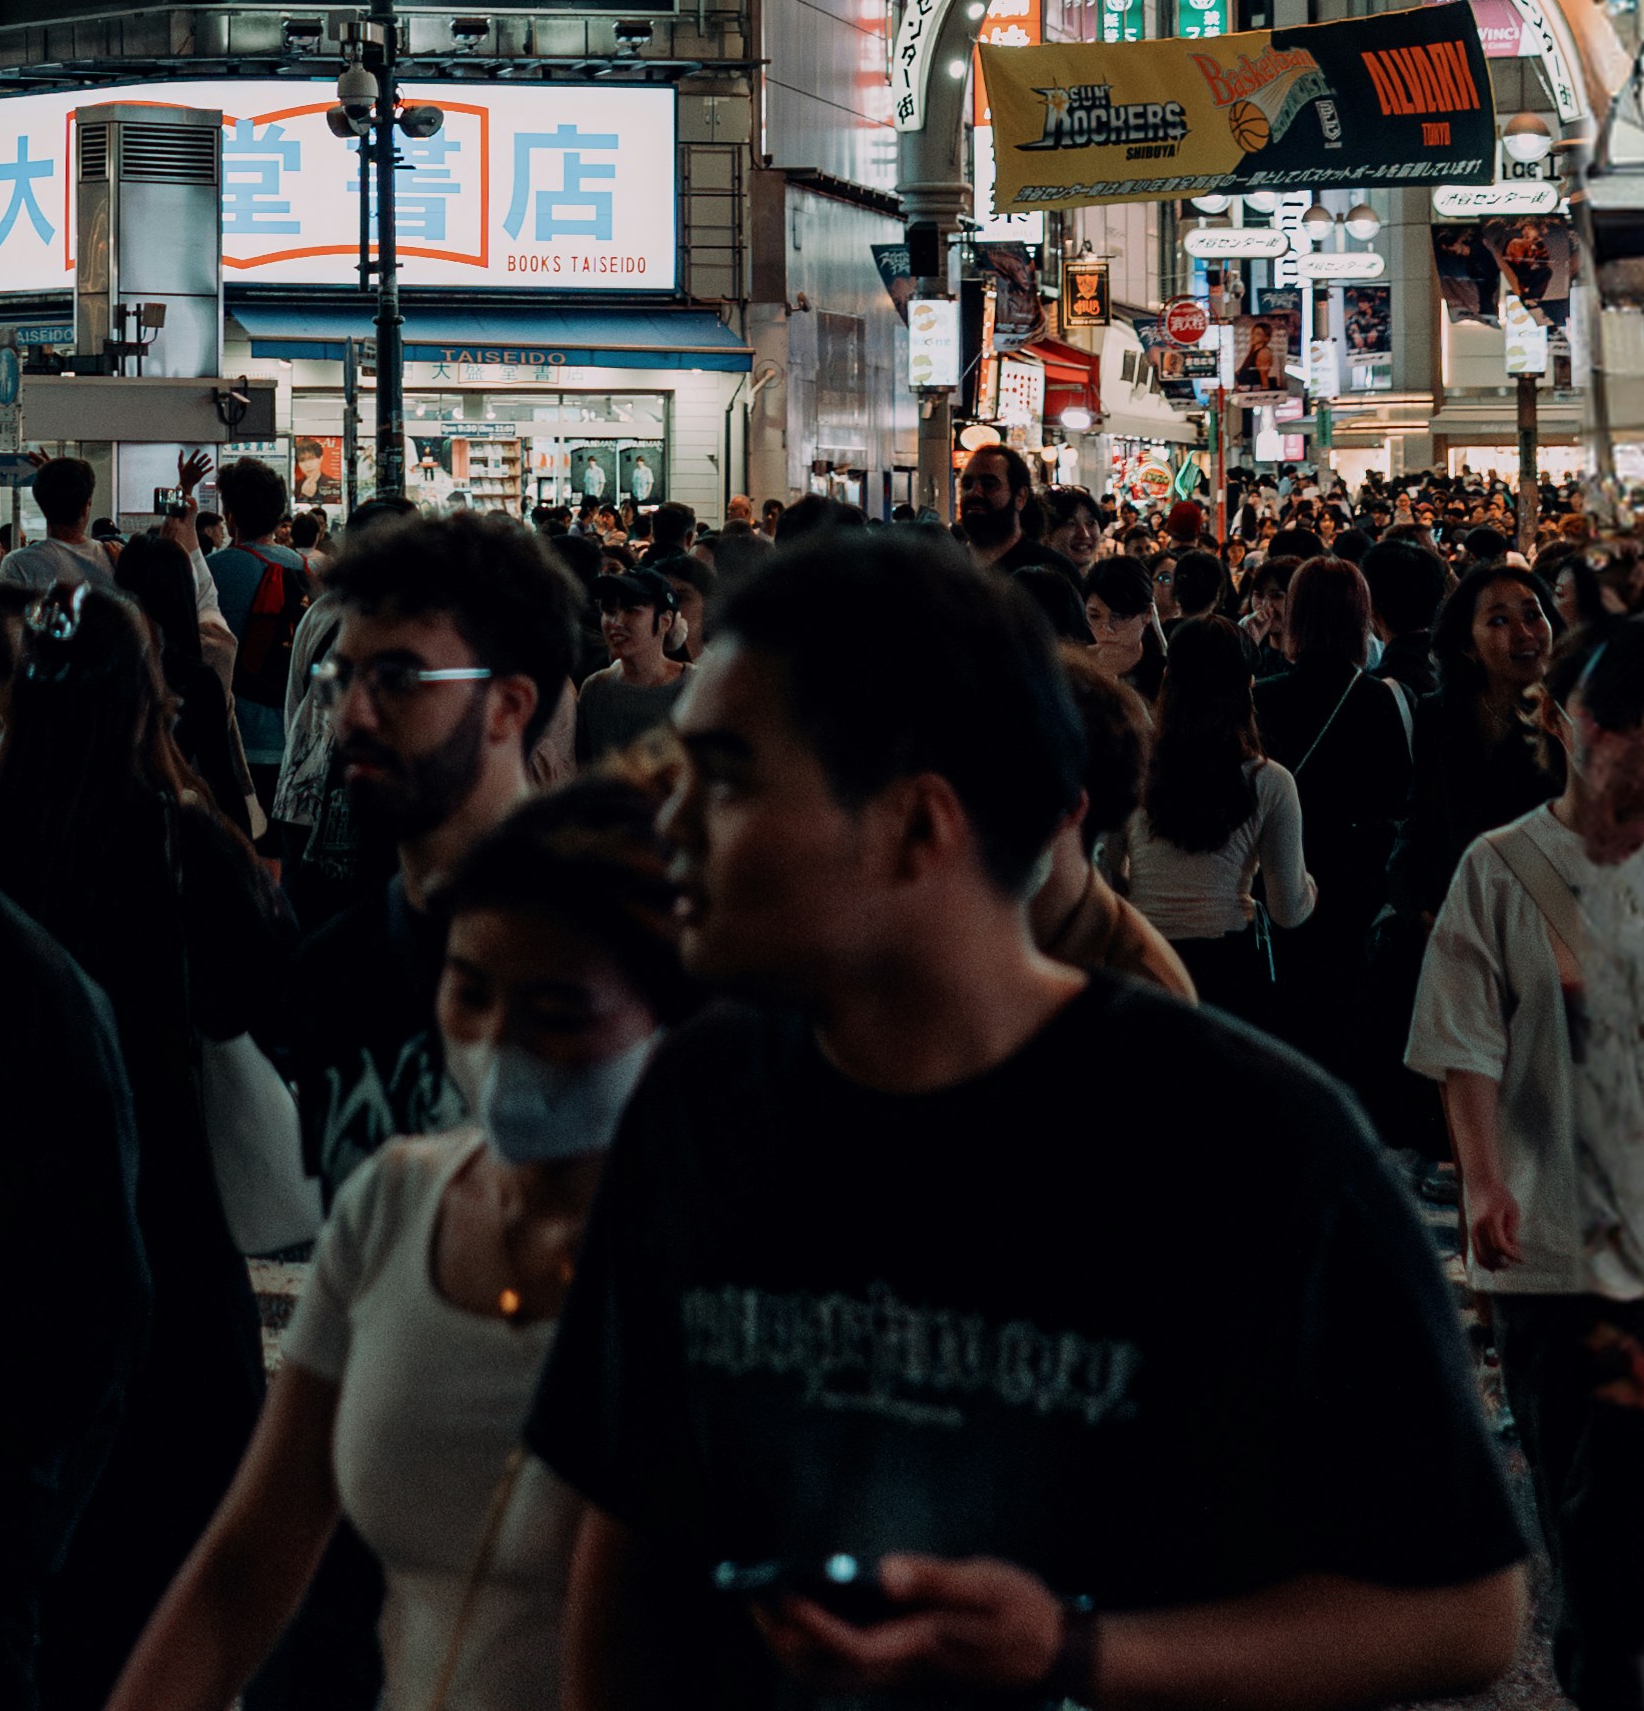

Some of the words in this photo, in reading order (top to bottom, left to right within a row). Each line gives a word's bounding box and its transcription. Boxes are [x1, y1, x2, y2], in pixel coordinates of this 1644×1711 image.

[1069, 85, 1110, 104] SUN
[1044, 87, 1188, 150] ROCKERS
[1125, 145, 1176, 162] SHIBUYA
[1440, 191, 1550, 207] 渋谷センター街
[1190, 233, 1281, 250] 渋谷センター街
[507, 255, 562, 273] BOOKS
[571, 256, 647, 275] TAISEIDO
[1073, 299, 1101, 316] HUB
[1170, 313, 1206, 331] 消火栓
[440, 349, 567, 365] TAISEIDO
[431, 361, 585, 381] 大盛堂書店
